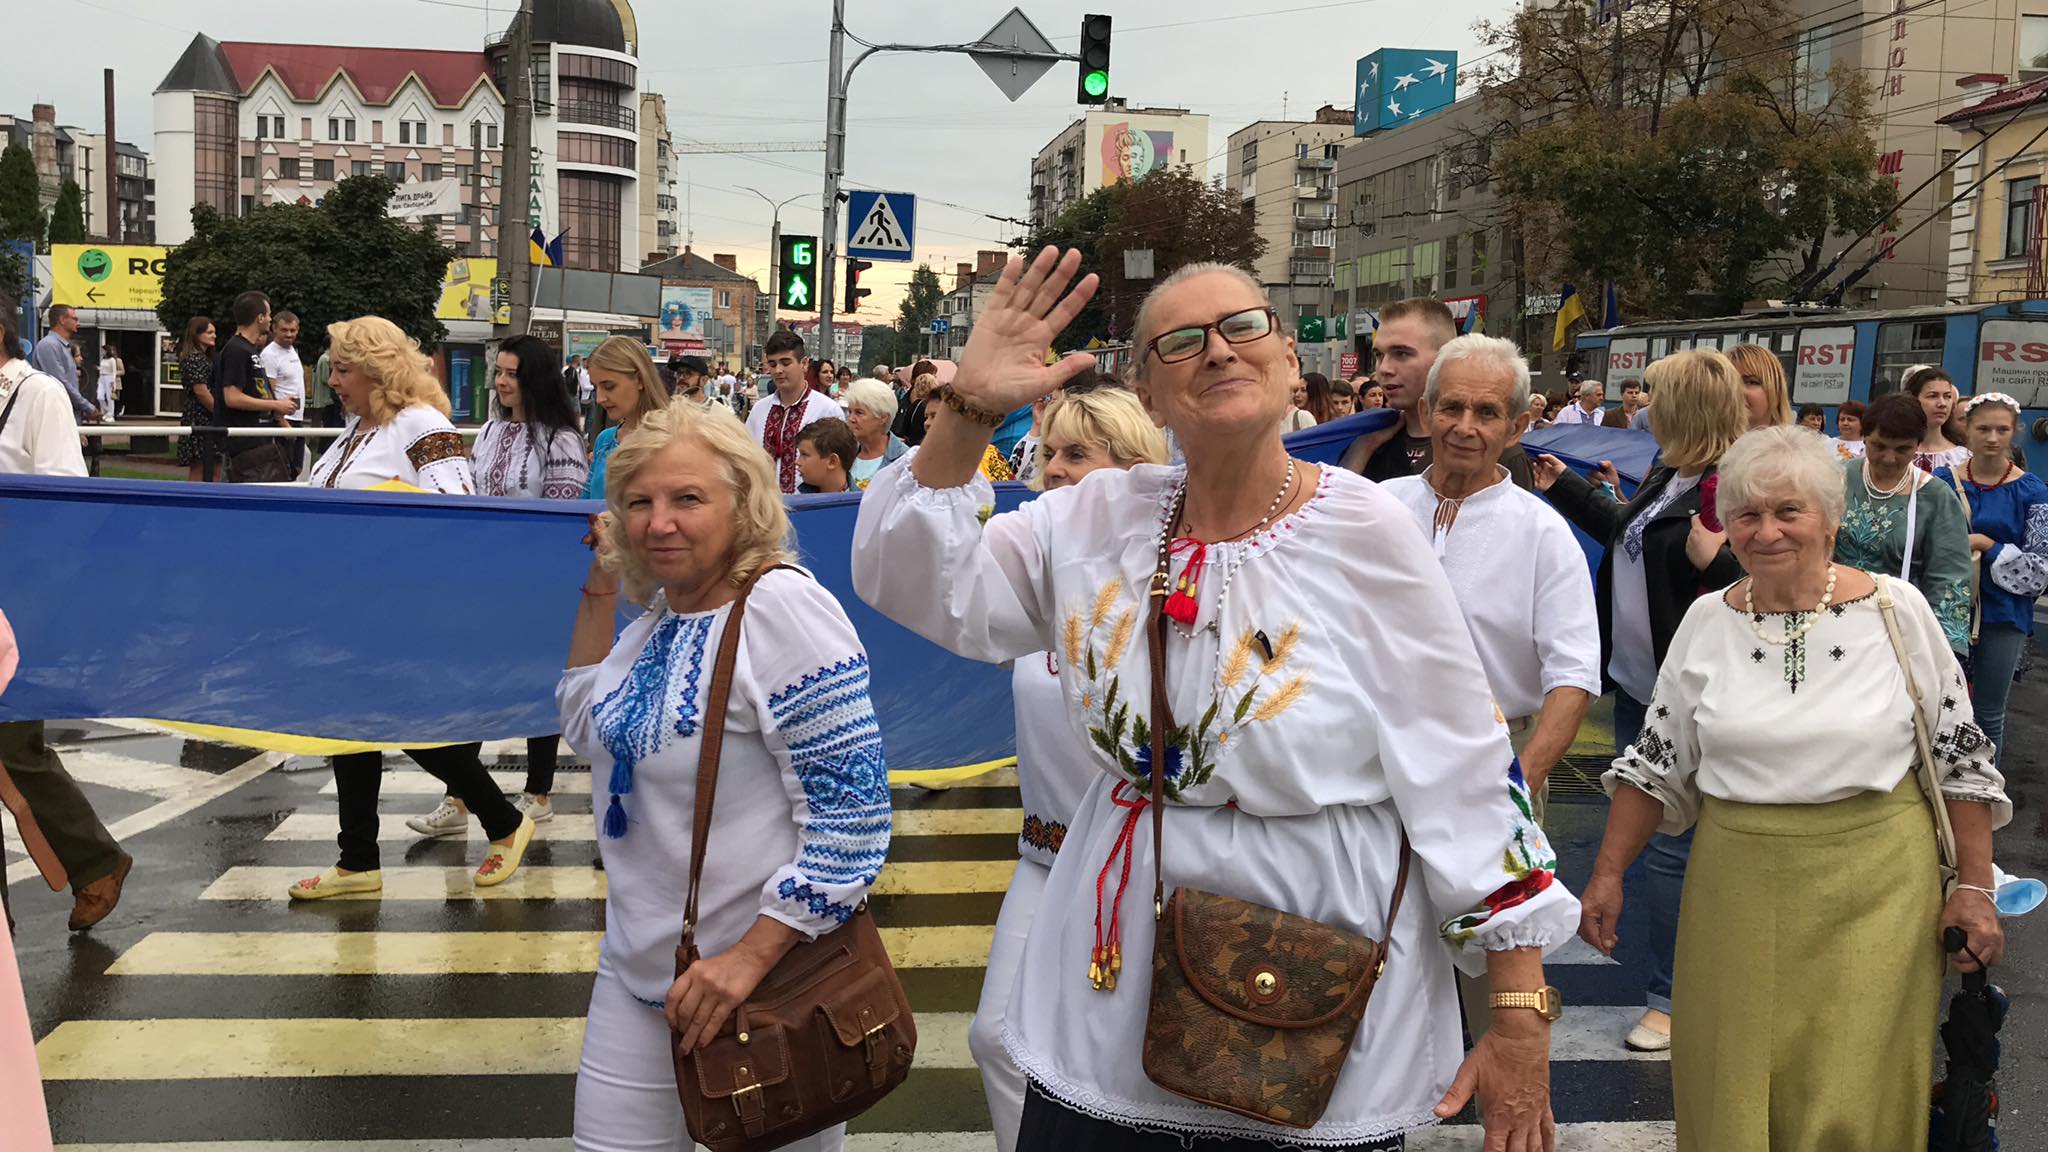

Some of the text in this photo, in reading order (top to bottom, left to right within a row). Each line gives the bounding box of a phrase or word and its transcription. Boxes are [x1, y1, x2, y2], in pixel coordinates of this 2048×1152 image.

[793, 243, 811, 265] 16
[1609, 351, 1647, 369] RST
[1798, 343, 1856, 366] RST
[1992, 367, 2031, 376] Машини
